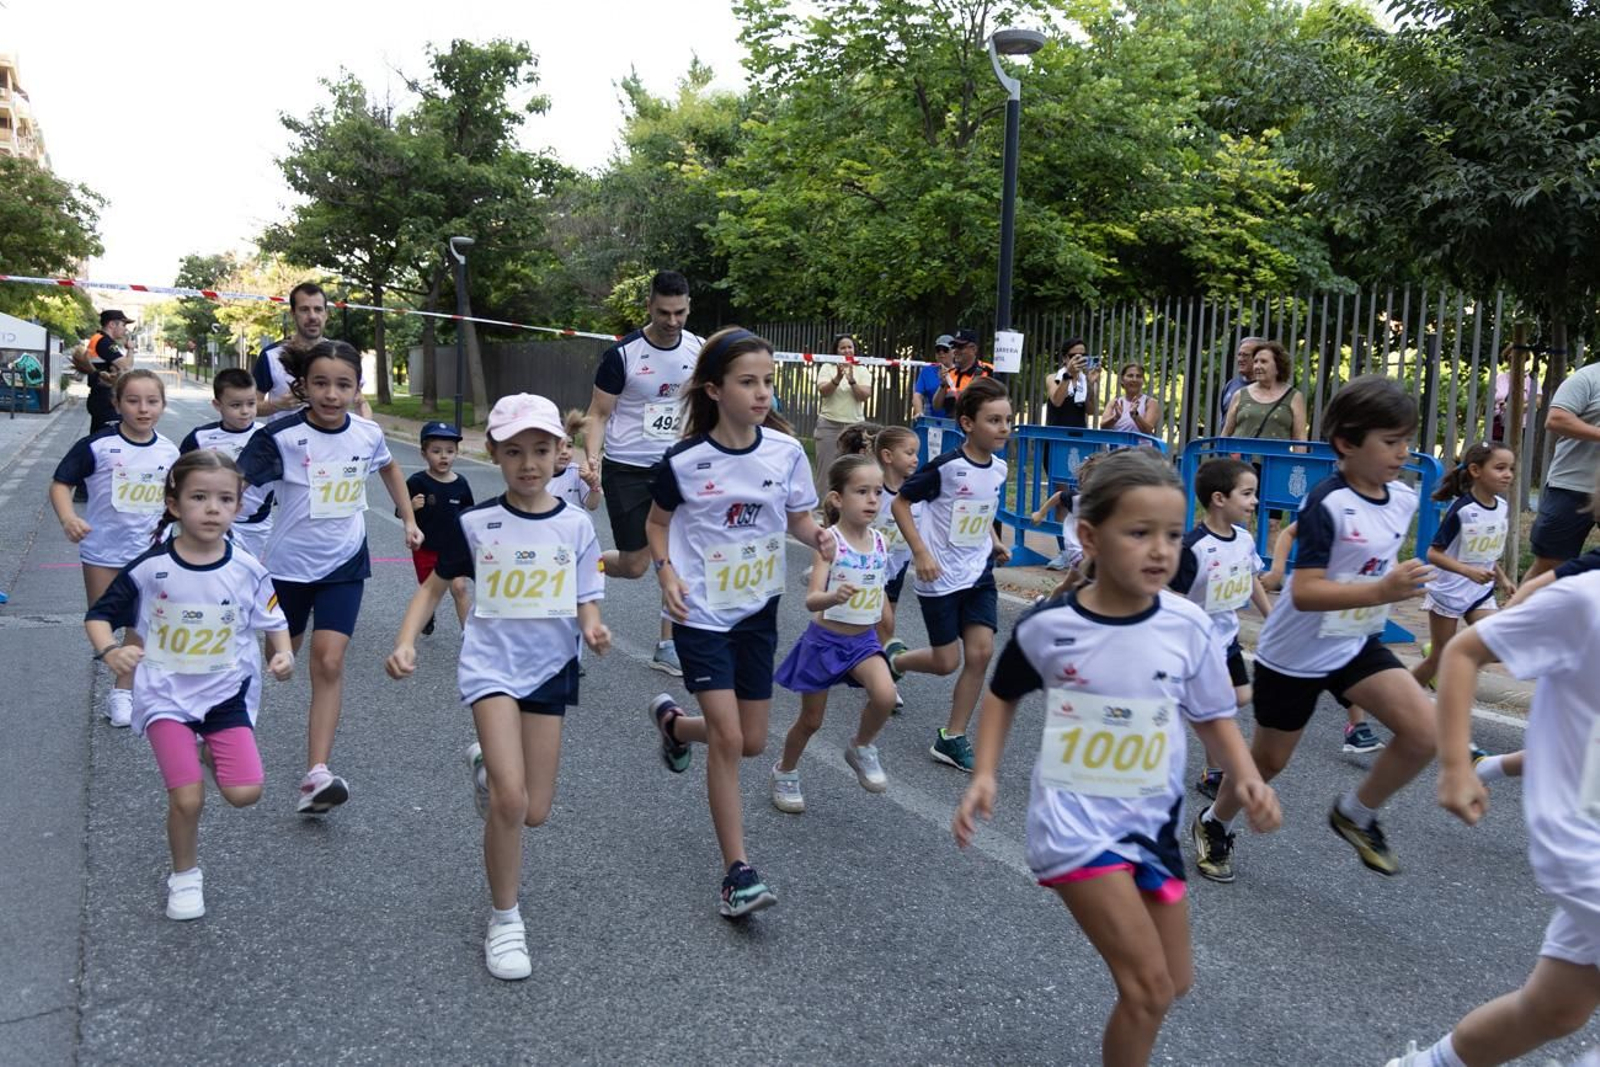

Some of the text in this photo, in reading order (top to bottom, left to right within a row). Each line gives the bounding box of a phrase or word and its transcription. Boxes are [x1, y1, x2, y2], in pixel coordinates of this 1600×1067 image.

[320, 479, 362, 503] 102
[486, 569, 566, 598] 1021
[716, 554, 776, 591] 1031
[157, 624, 232, 655] 1022
[1061, 727, 1167, 772] 1000
